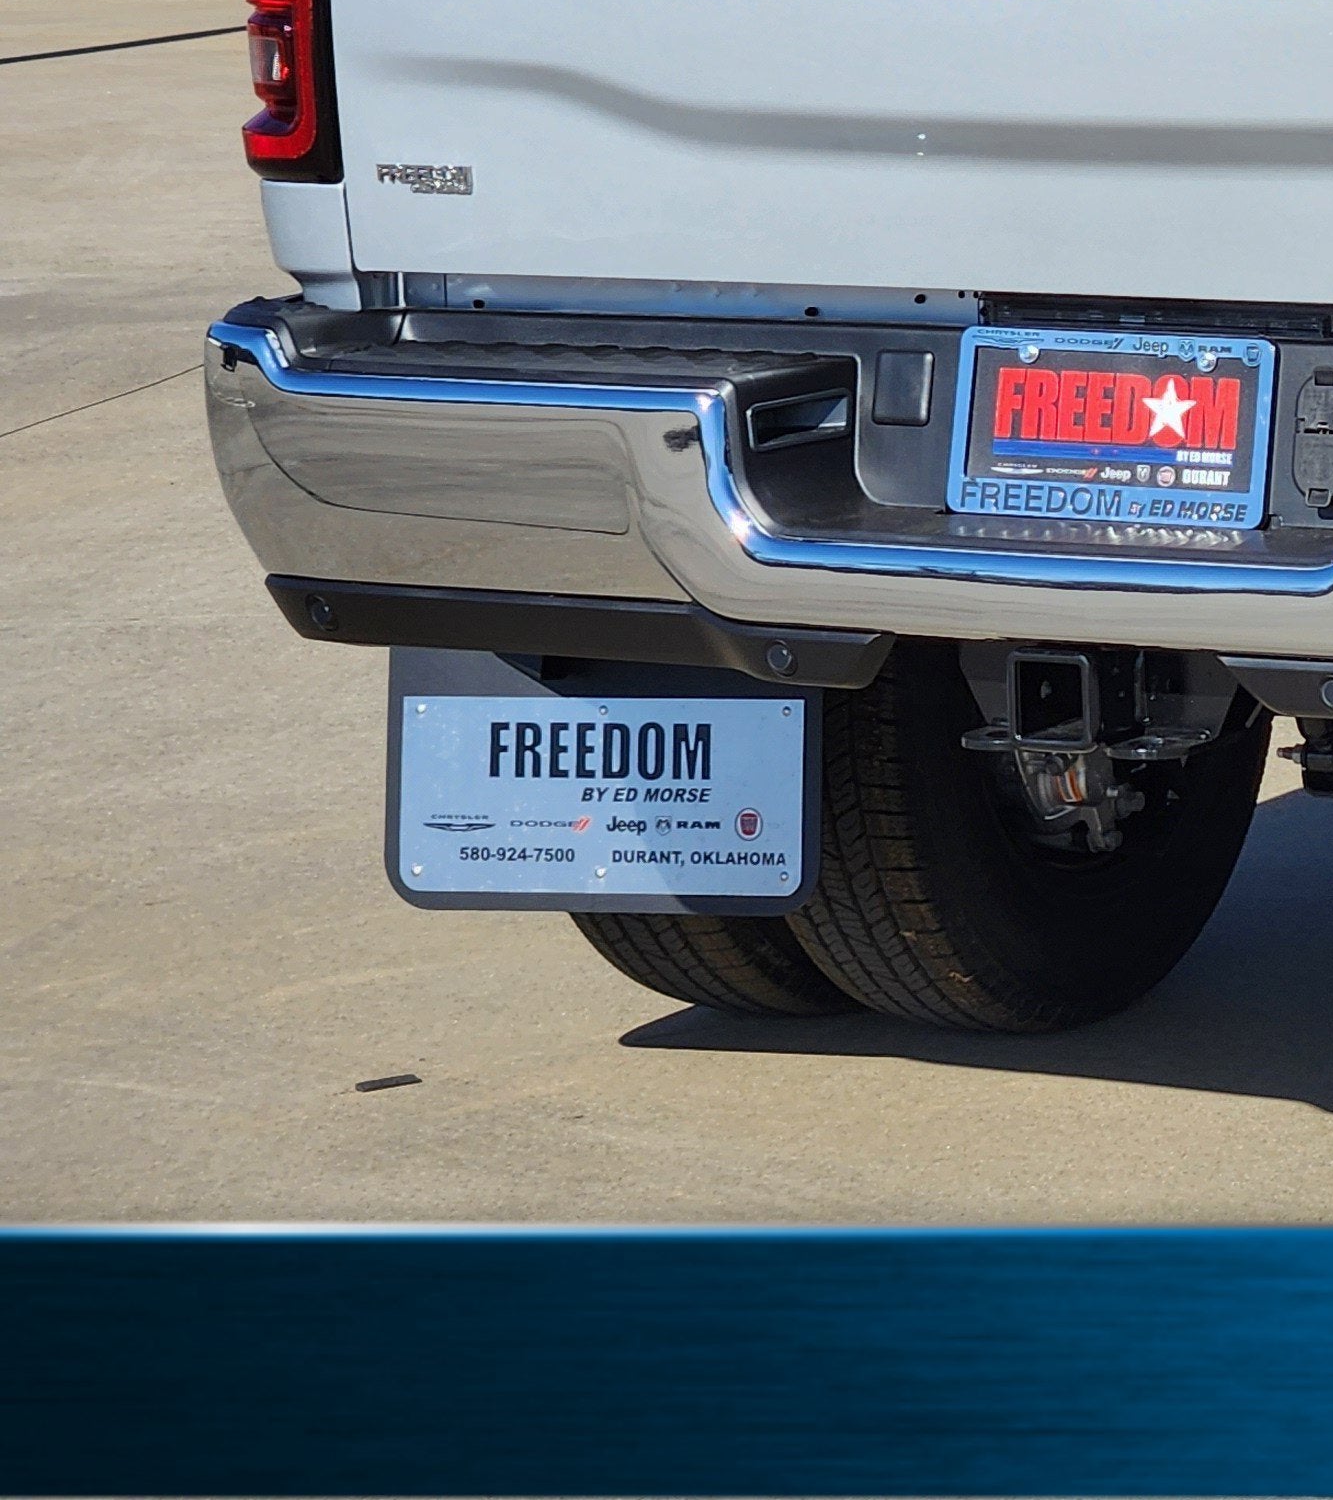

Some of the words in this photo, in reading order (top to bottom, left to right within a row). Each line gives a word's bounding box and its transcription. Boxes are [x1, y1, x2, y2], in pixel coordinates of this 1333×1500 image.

[1133, 337, 1169, 355] Jeep
[1197, 345, 1232, 354] RAM
[994, 367, 1240, 450] FREEDOM
[1100, 467, 1132, 481] Jeep
[1181, 468, 1231, 486] DURANT
[960, 480, 1123, 518] FREEDOM
[1149, 499, 1175, 518] ED
[1177, 501, 1248, 522] MORSE
[489, 722, 712, 780] FREEDOM
[581, 787, 609, 802] BY
[613, 787, 639, 802] ED
[644, 788, 712, 803] MORSE
[606, 816, 647, 835] Jeep
[676, 821, 721, 829] RAM
[459, 847, 576, 862] 580-924-7500
[612, 850, 685, 866] DURANT,
[690, 851, 787, 866] OKLAHOMA
